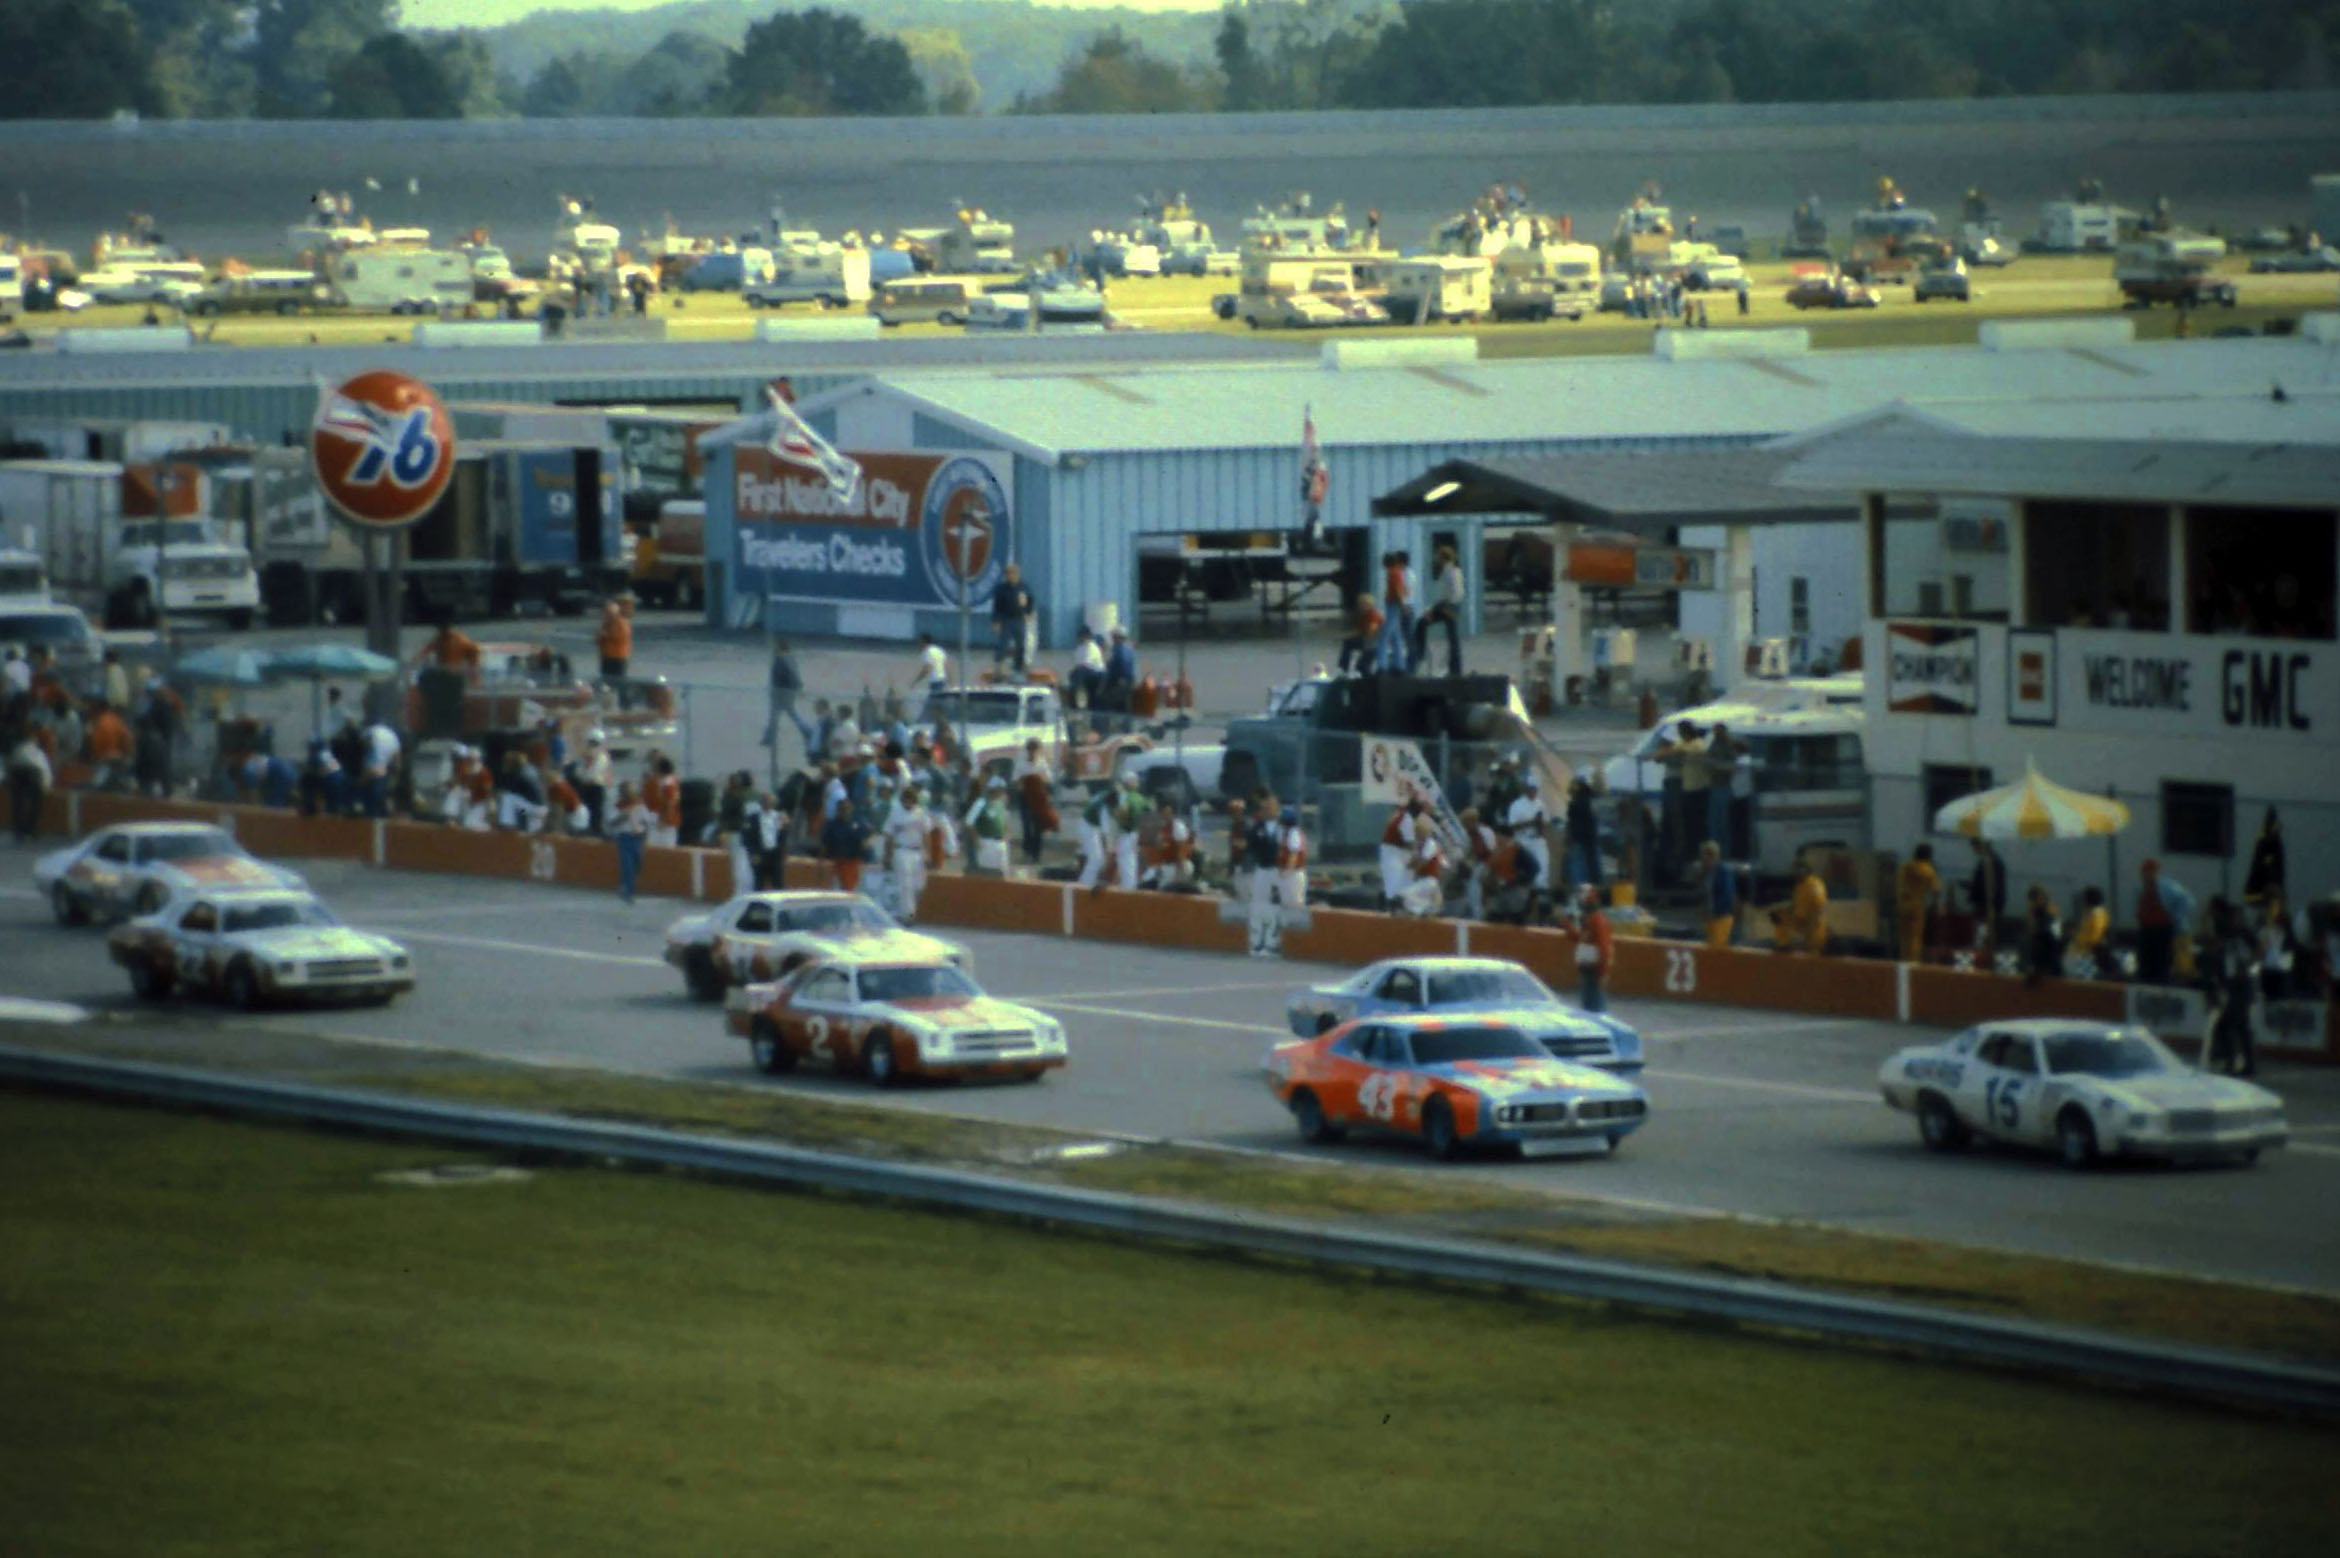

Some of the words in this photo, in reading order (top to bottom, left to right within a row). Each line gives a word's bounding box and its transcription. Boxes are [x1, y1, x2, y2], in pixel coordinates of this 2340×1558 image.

[737, 472, 782, 514] First
[870, 478, 909, 528] City
[740, 529, 825, 572] Travelers
[830, 532, 905, 577] Checks
[1893, 653, 1974, 684] CHAMPION
[2086, 656, 2189, 712] WELCOME
[2223, 649, 2310, 731] GMC
[1667, 950, 1696, 991] 23
[805, 1015, 834, 1060] 2
[1986, 1075, 2022, 1128] 15
